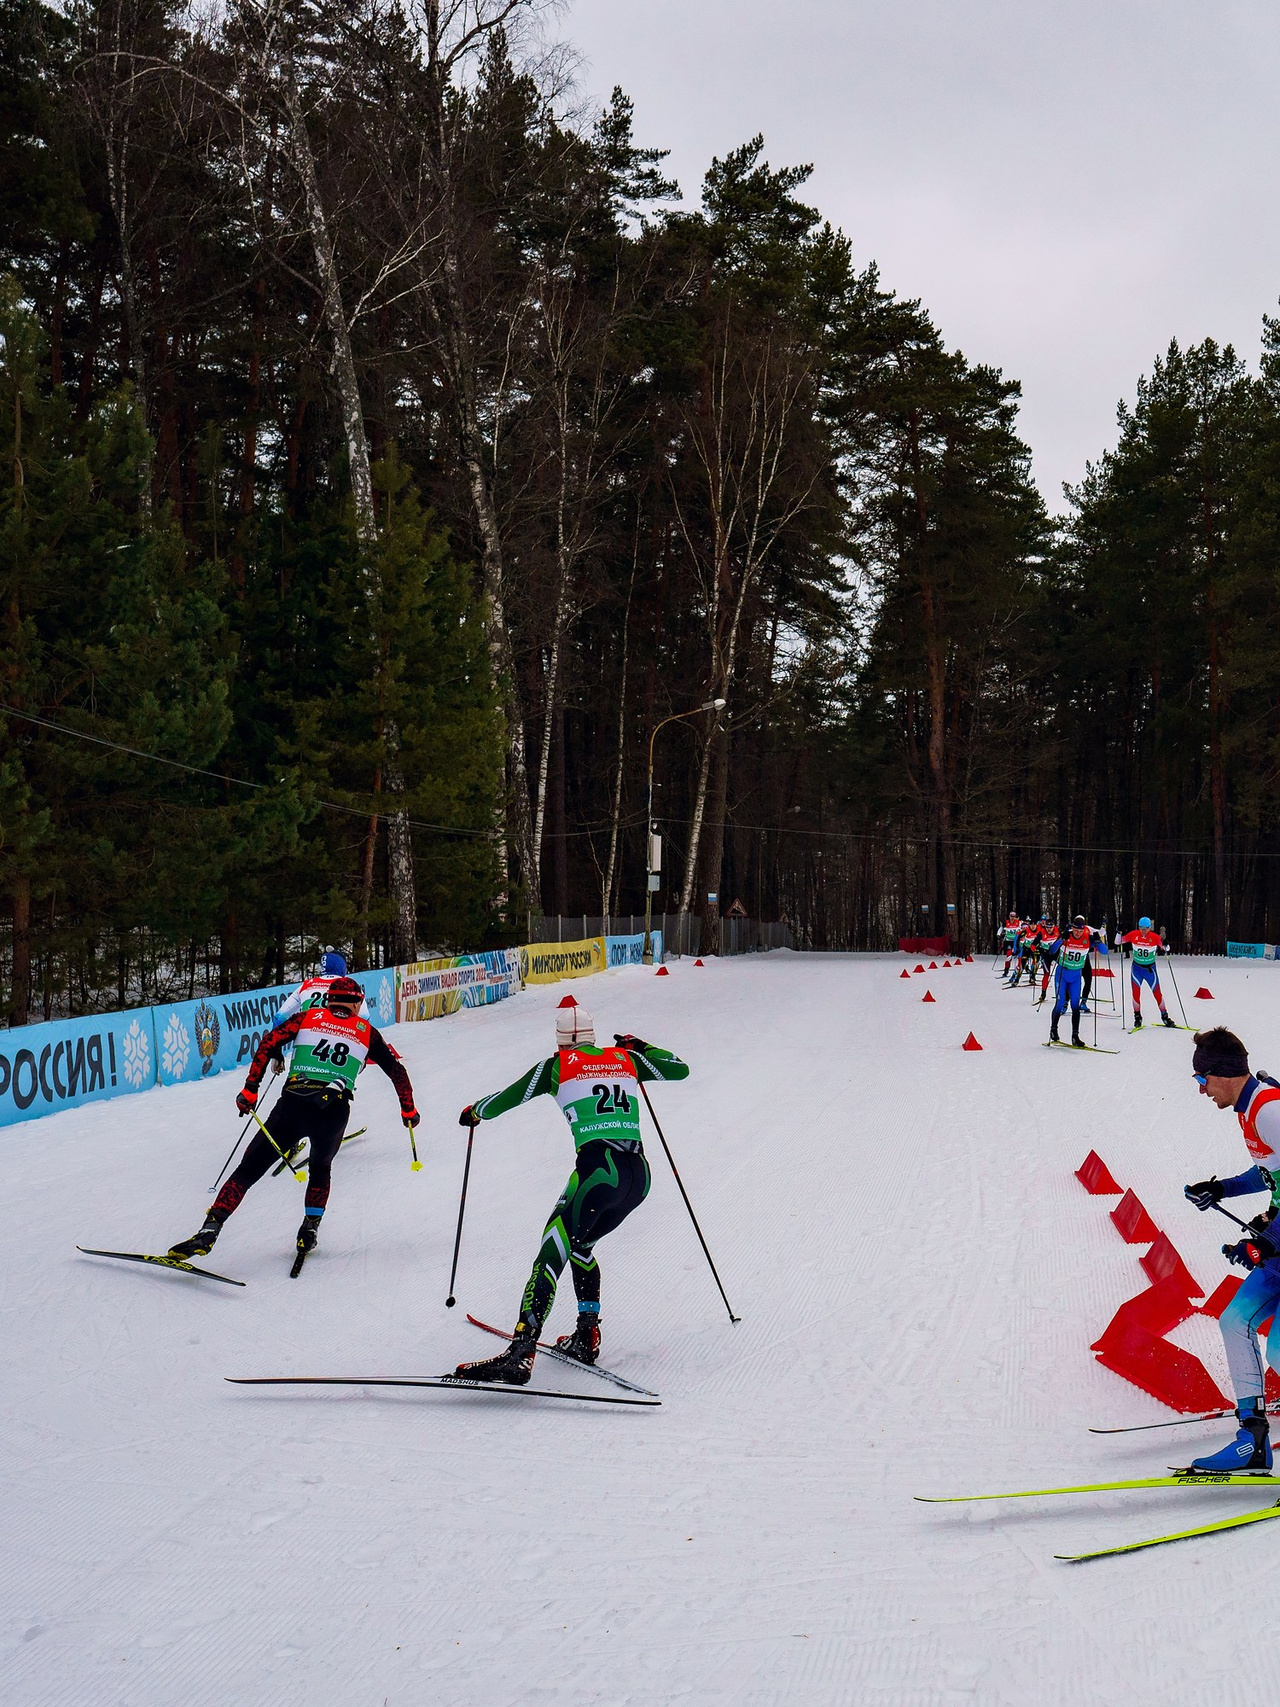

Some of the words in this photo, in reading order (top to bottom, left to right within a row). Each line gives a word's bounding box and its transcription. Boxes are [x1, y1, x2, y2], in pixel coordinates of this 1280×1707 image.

[1067, 951, 1081, 962] 50
[1137, 948, 1149, 958] 36
[401, 980, 418, 999] ДЕНЬ
[440, 972, 458, 990] ВИДОВ
[320, 1021, 357, 1035] ФЕДЕРАЦИЯ
[311, 1038, 350, 1067] 48
[582, 1063, 623, 1071] ФЕДЕРАЦИЯ
[592, 1084, 631, 1115] 24
[580, 1120, 622, 1133] КАЛУЖСКОЙ
[151, 1256, 193, 1270] FISCHER
[522, 1262, 541, 1311] RUSSIA
[440, 1378, 479, 1386] MADSHUS
[1177, 1476, 1231, 1484] FISCHER
